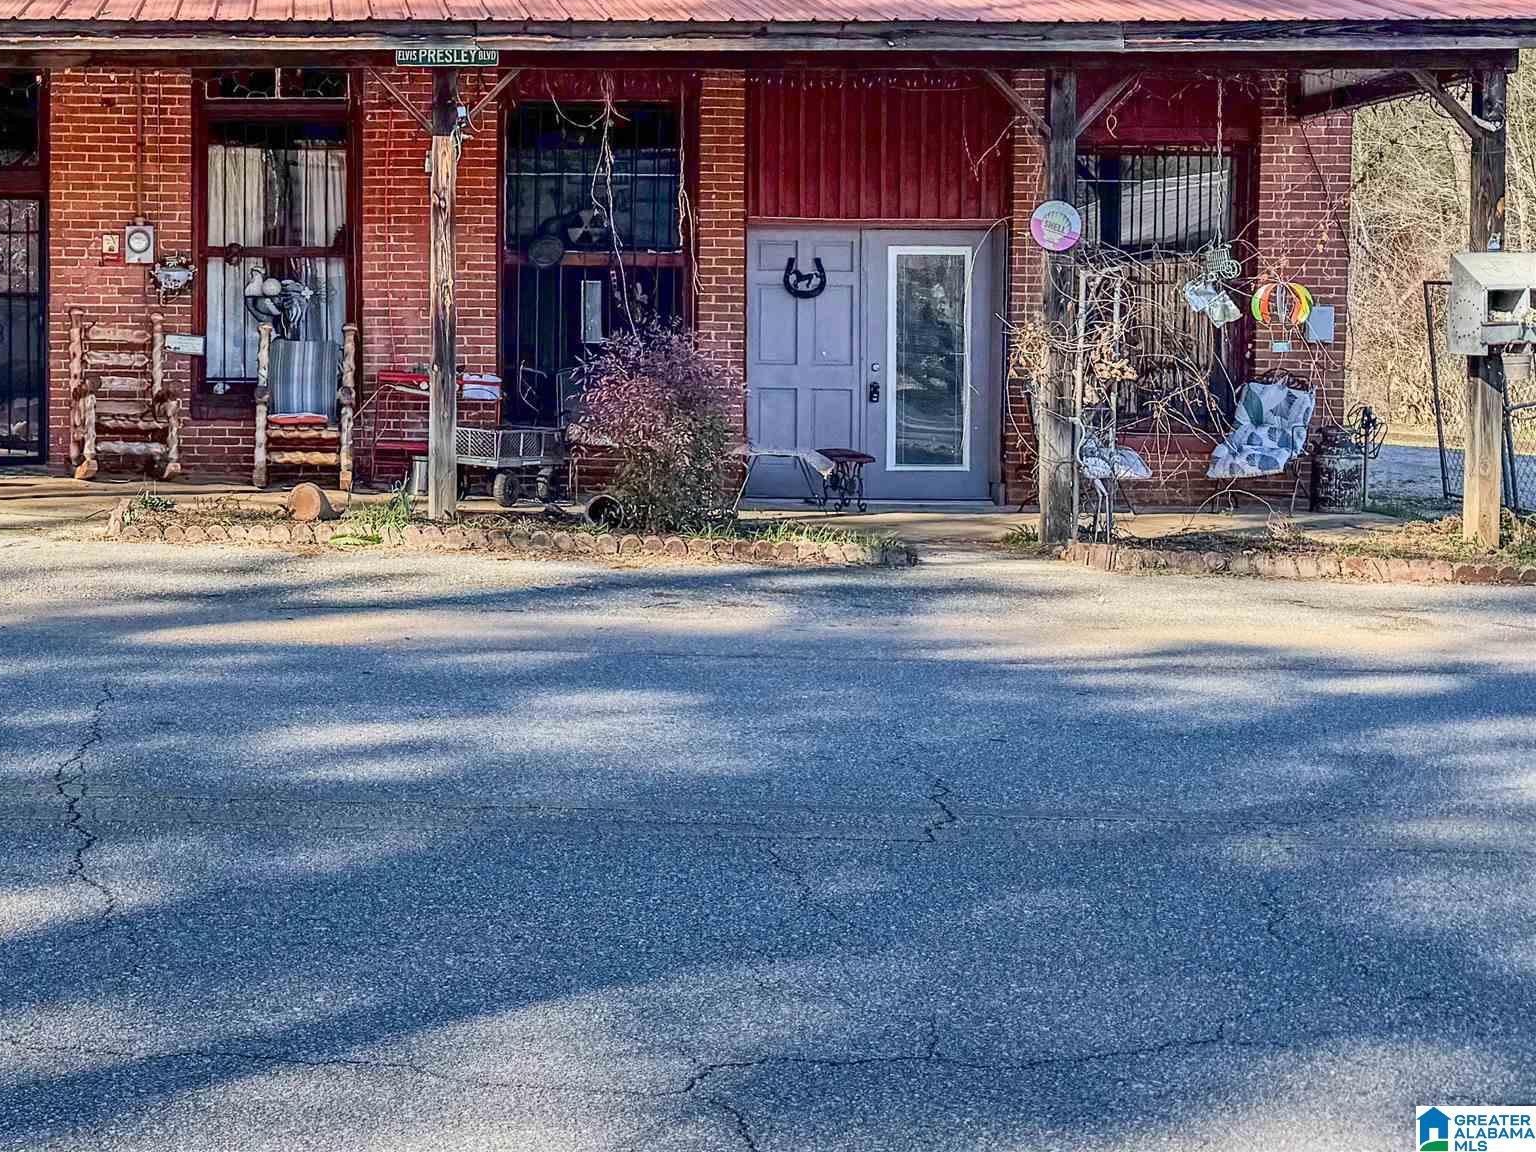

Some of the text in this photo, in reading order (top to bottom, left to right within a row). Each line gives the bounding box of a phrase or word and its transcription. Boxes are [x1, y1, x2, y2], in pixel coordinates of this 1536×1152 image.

[397, 49, 497, 63] ELVIS PRESLEY BLVD
